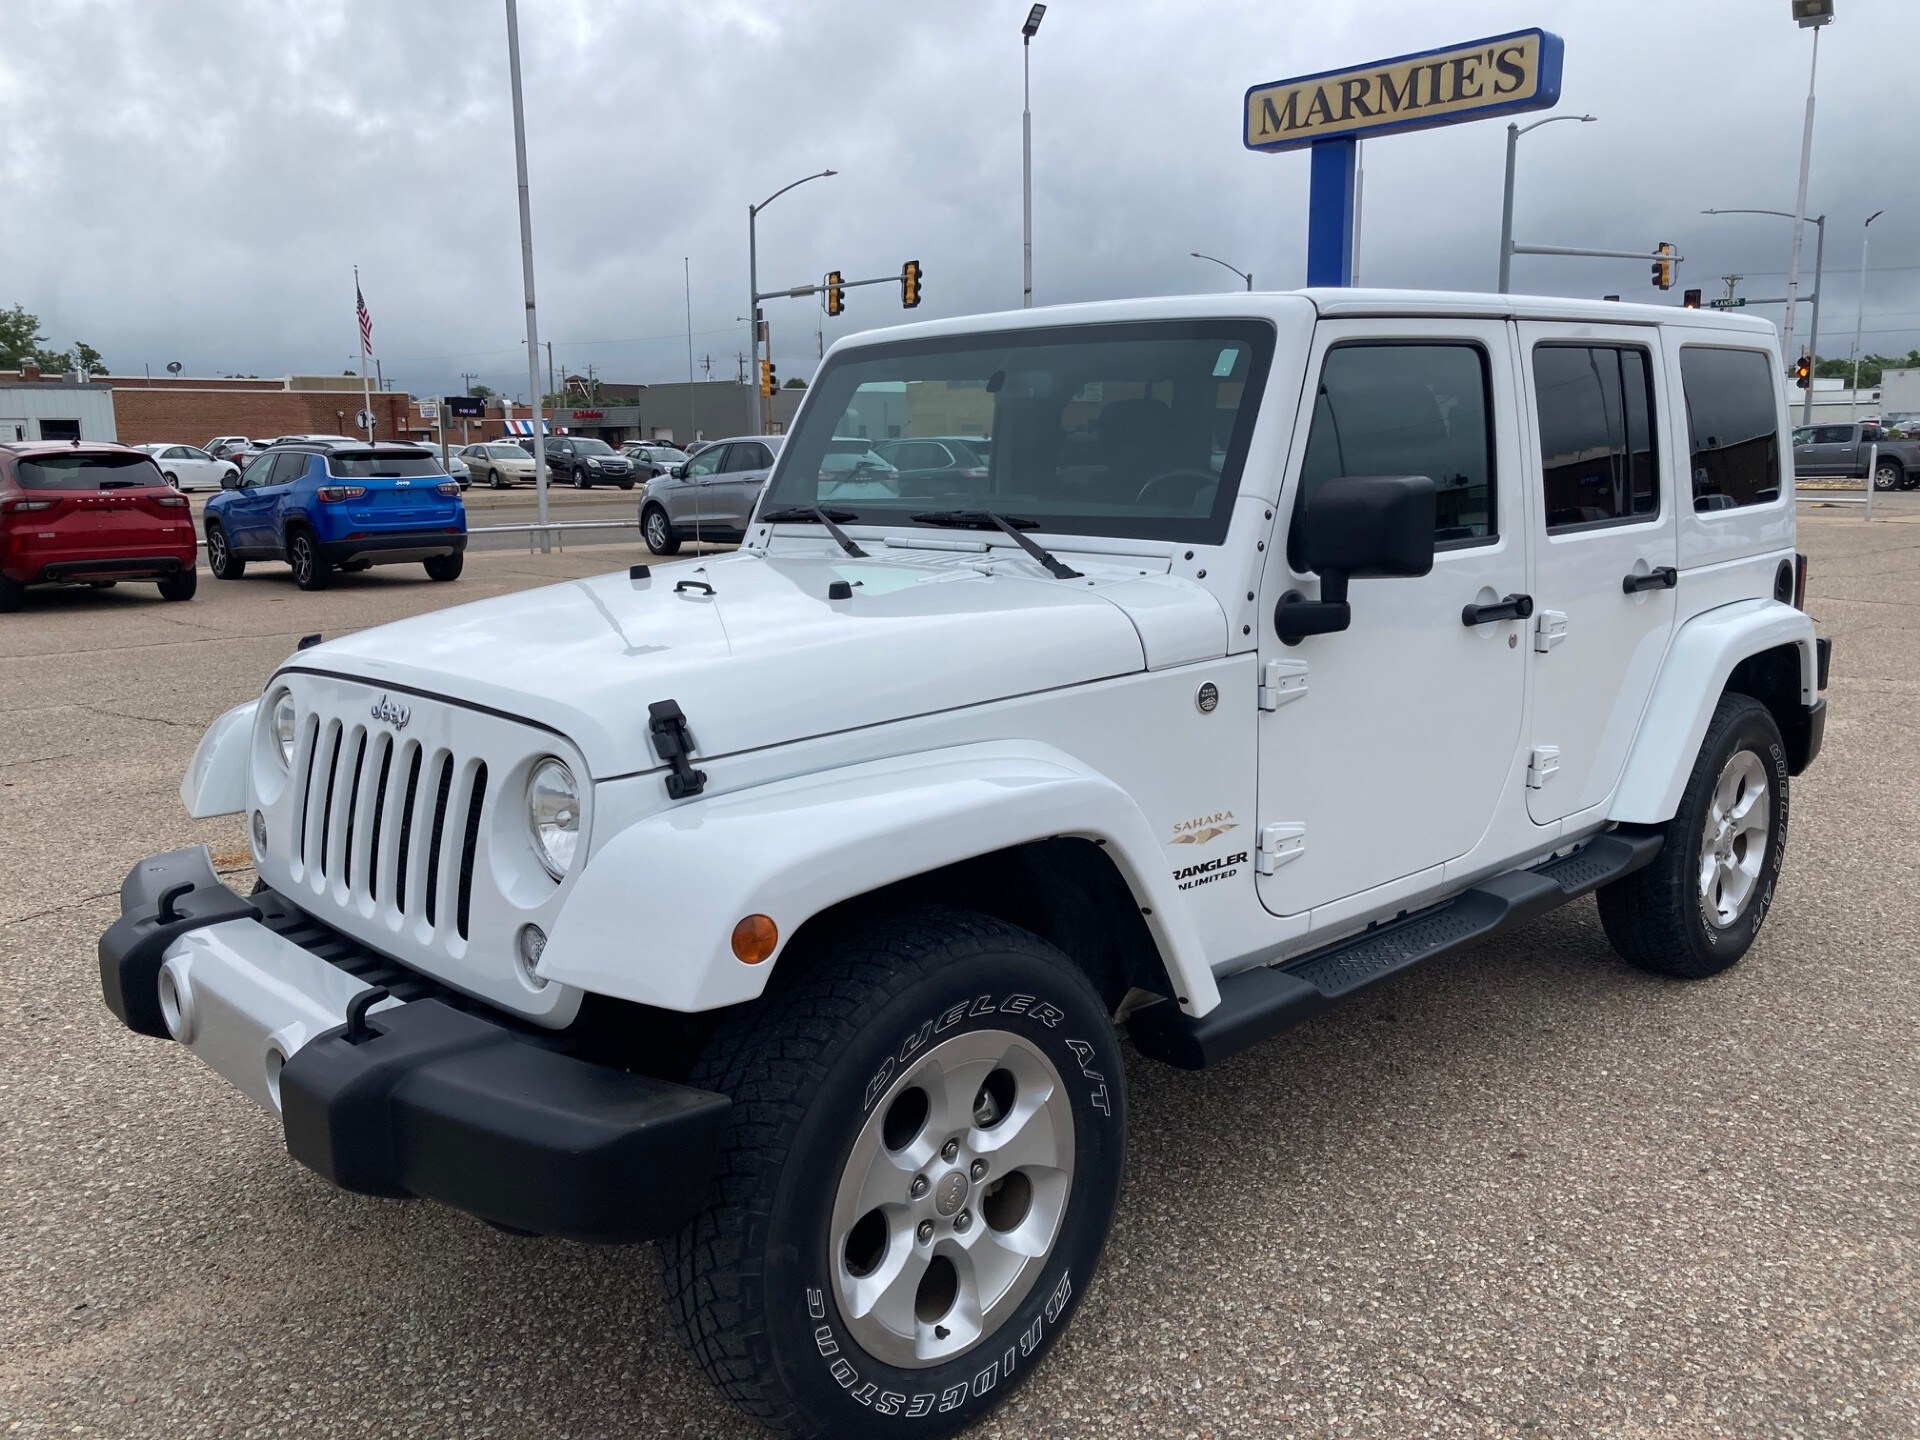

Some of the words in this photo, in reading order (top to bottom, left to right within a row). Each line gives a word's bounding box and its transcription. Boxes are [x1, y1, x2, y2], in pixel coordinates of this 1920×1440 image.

[1258, 45, 1526, 135] MARMIE'S
[371, 694, 411, 731] Jeep
[1173, 810, 1234, 833] SAHARA
[1769, 743, 1788, 873] DUELER
[1172, 851, 1248, 880] RANGLER
[1178, 869, 1237, 891] NLIMITED
[864, 993, 1065, 1112] DUELER
[806, 1270, 1072, 1418] BRIDGESTONE
